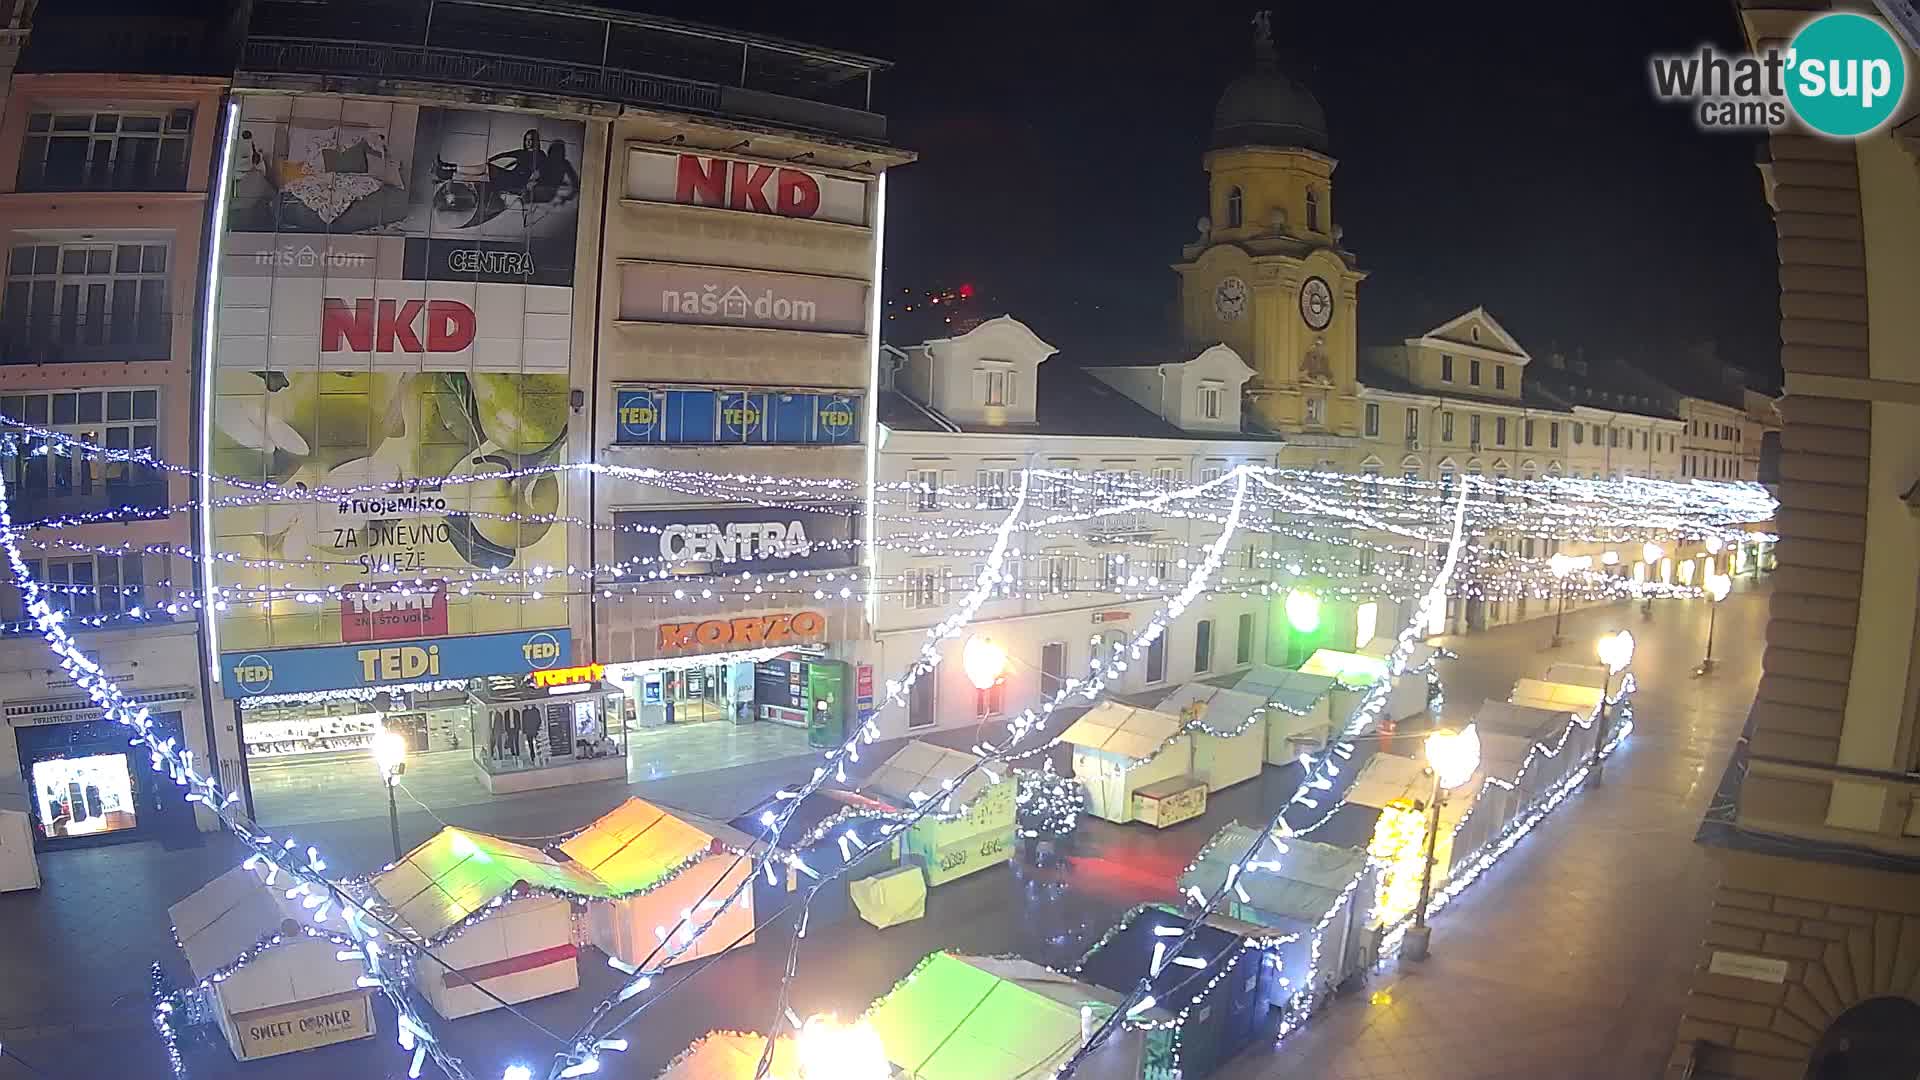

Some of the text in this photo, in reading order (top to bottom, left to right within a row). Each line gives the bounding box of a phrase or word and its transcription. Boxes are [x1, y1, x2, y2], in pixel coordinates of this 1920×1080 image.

[675, 153, 821, 219] NKD
[320, 246, 366, 268] dom
[448, 248, 535, 275] CENTRA
[661, 283, 817, 322] naš dom
[321, 298, 477, 353] NKD
[619, 407, 657, 424] TEDi
[723, 408, 760, 426] TEDi
[820, 410, 853, 426] TEDi
[338, 496, 447, 515] #TvojeMisto
[333, 523, 450, 549] ZA DNEVNO
[660, 520, 810, 560] CENTRA
[659, 611, 826, 649] KORZO
[522, 642, 560, 659] TEDi
[233, 665, 273, 683] TEDi
[358, 645, 440, 682] TEDi
[533, 663, 605, 688] TOMMY
[250, 1021, 292, 1041] SWEET
